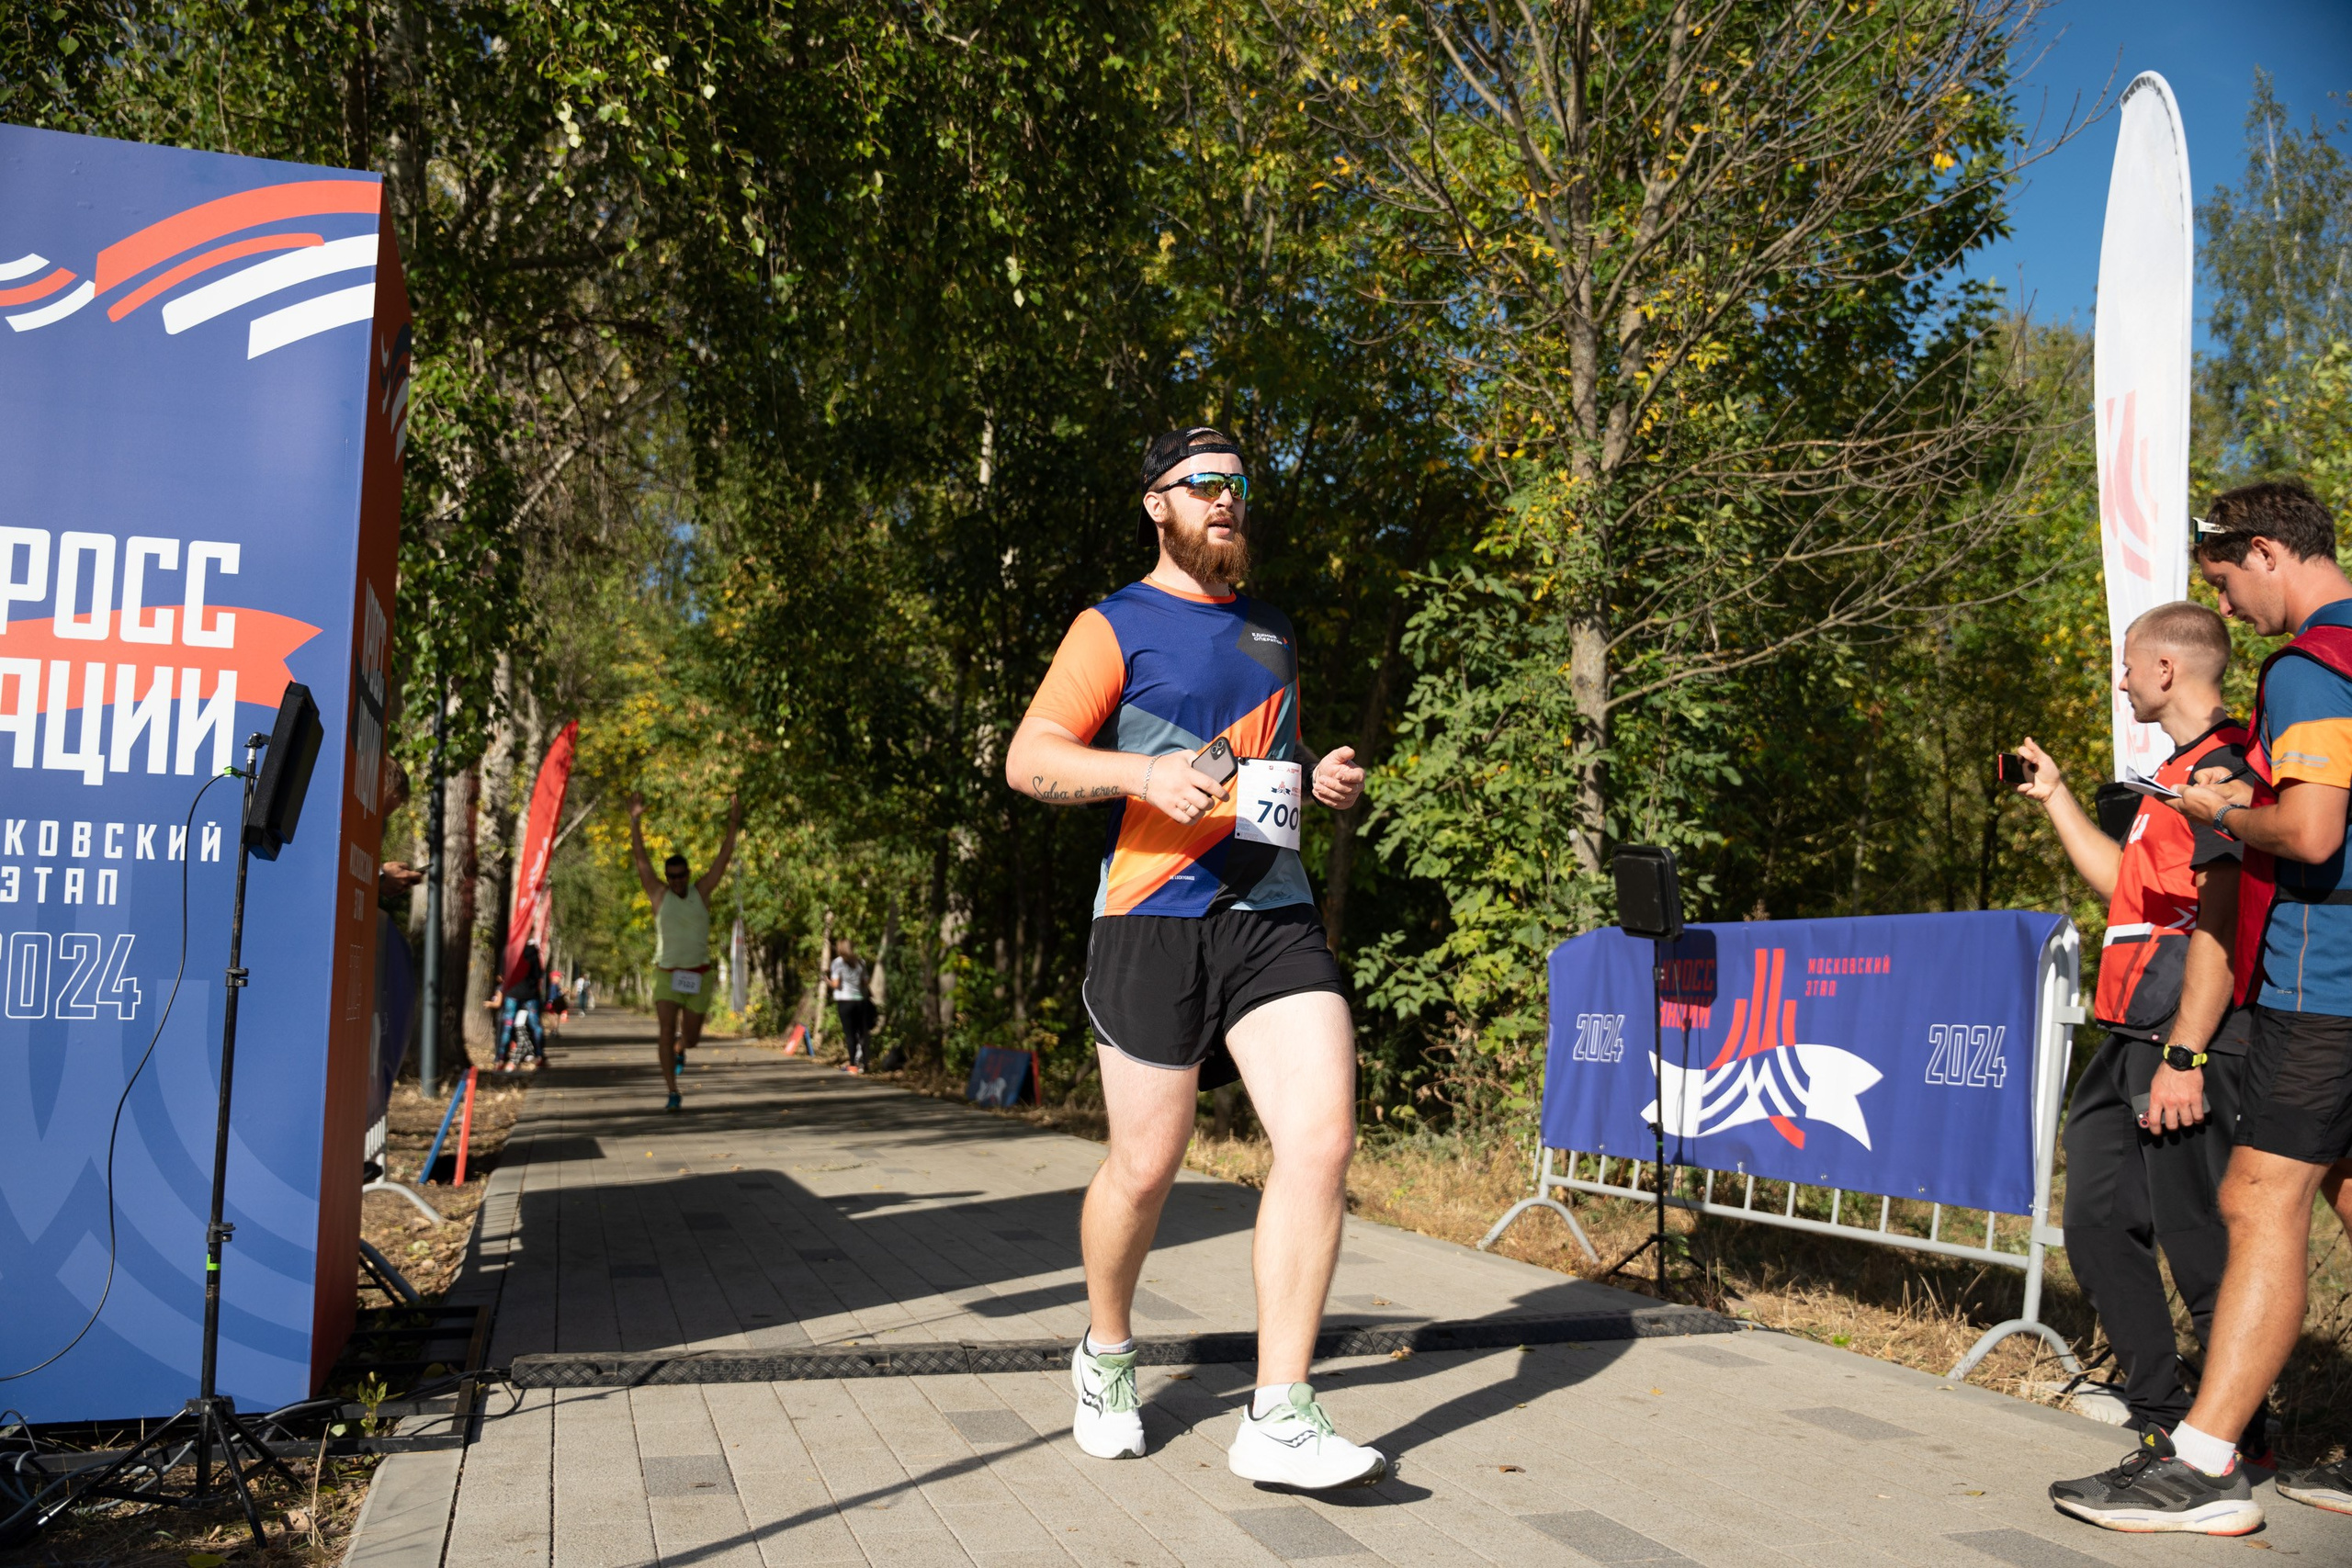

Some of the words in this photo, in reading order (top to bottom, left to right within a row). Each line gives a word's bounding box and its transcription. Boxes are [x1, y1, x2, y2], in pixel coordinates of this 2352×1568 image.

[1074, 786, 1086, 798] et
[1257, 799, 1300, 831] 700
[0, 865, 119, 906] ЭТАП
[0, 931, 142, 1021] 024
[1659, 959, 1716, 991] КРОСС
[1807, 953, 1891, 975] МОСКОВСКИЙ
[1804, 980, 1837, 998] ЭТАП
[1572, 1013, 1625, 1064] 2024
[1925, 1023, 2007, 1089] 2024
